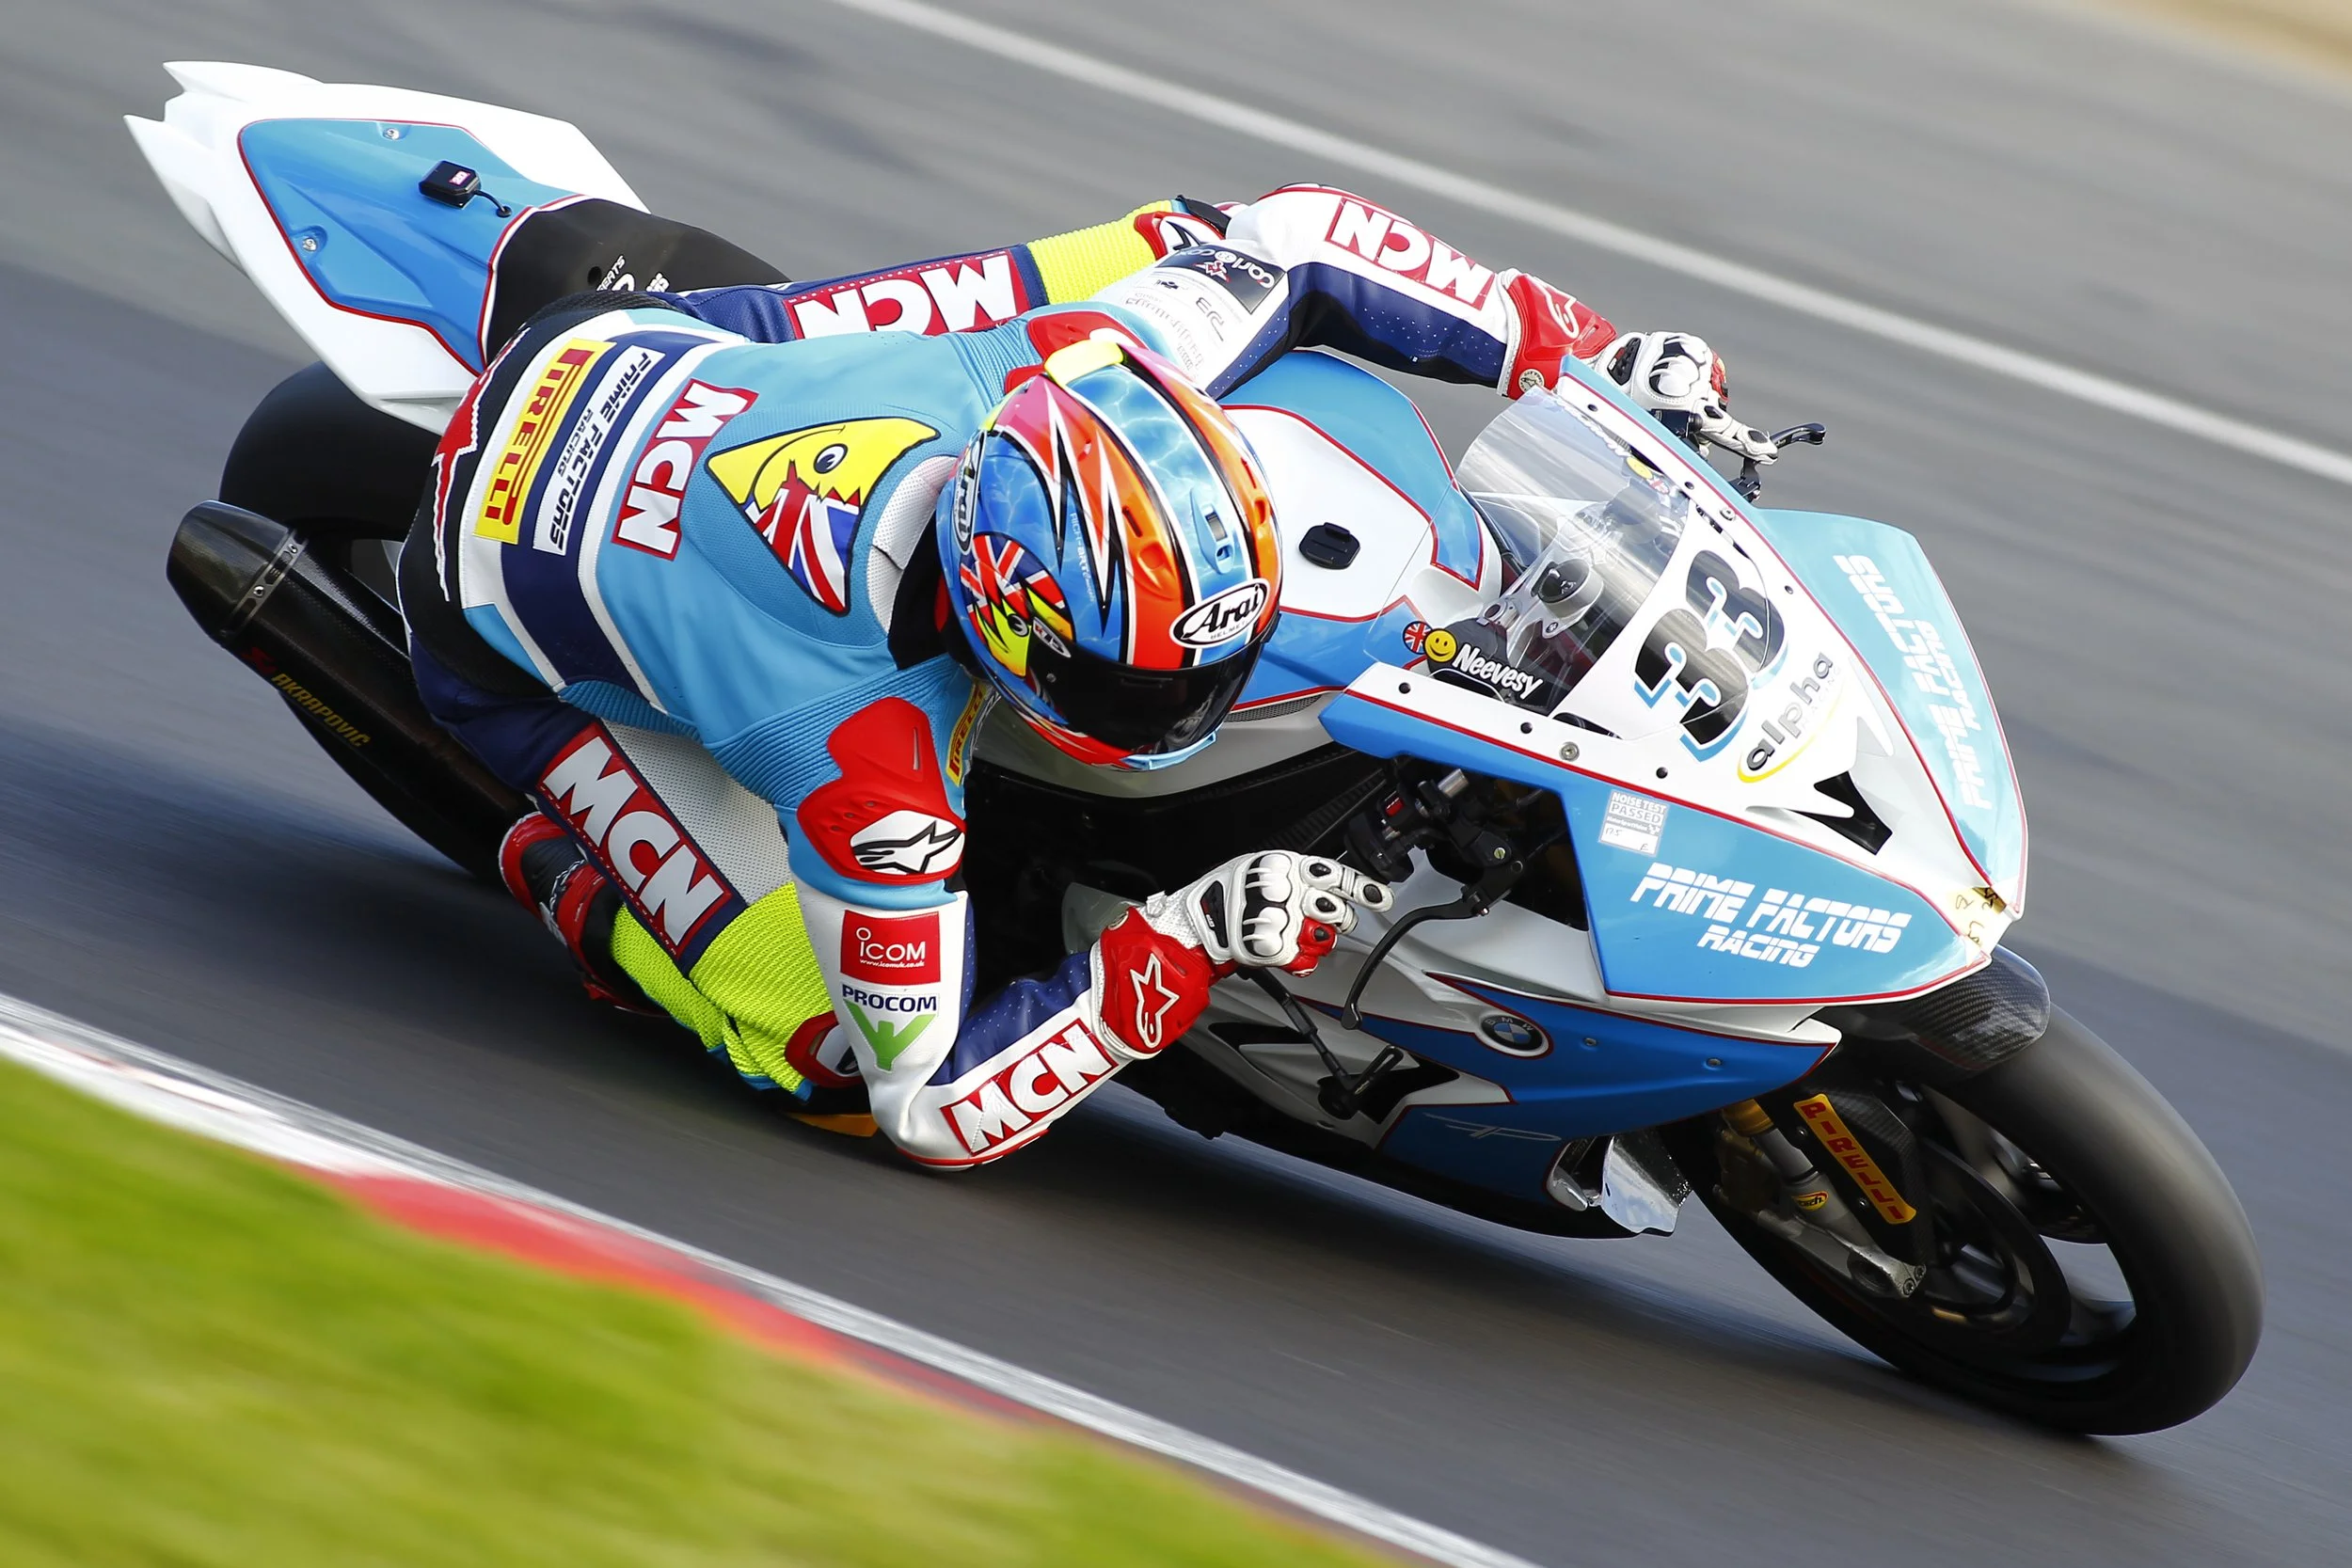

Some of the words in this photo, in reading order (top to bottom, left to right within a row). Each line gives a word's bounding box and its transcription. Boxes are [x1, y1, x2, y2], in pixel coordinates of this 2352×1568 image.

[795, 252, 1019, 339] MCN
[1332, 201, 1496, 304] MCN
[599, 352, 653, 425] PRIME
[485, 350, 593, 526] PIRELLI
[557, 408, 594, 478] RACING
[617, 382, 751, 555] MCN
[549, 423, 604, 552] FACTORS
[1182, 583, 1262, 639] Arai
[1634, 550, 1786, 745] 33
[1454, 643, 1543, 701] Neevesy
[1747, 652, 1833, 770] alpha
[543, 736, 723, 946] MCN
[1611, 803, 1661, 824] PASSED
[1612, 792, 1643, 809] NOISE
[1643, 800, 1667, 815] TEST
[1629, 862, 1756, 924] PRIME
[1745, 888, 1913, 954] FACTORS
[1696, 925, 1821, 969] RACING
[842, 984, 938, 1012] PROCOM
[859, 958, 926, 969] www.icomuk.co.uk
[951, 1022, 1115, 1154] MCN
[1801, 1102, 1904, 1220] PIRELLI
